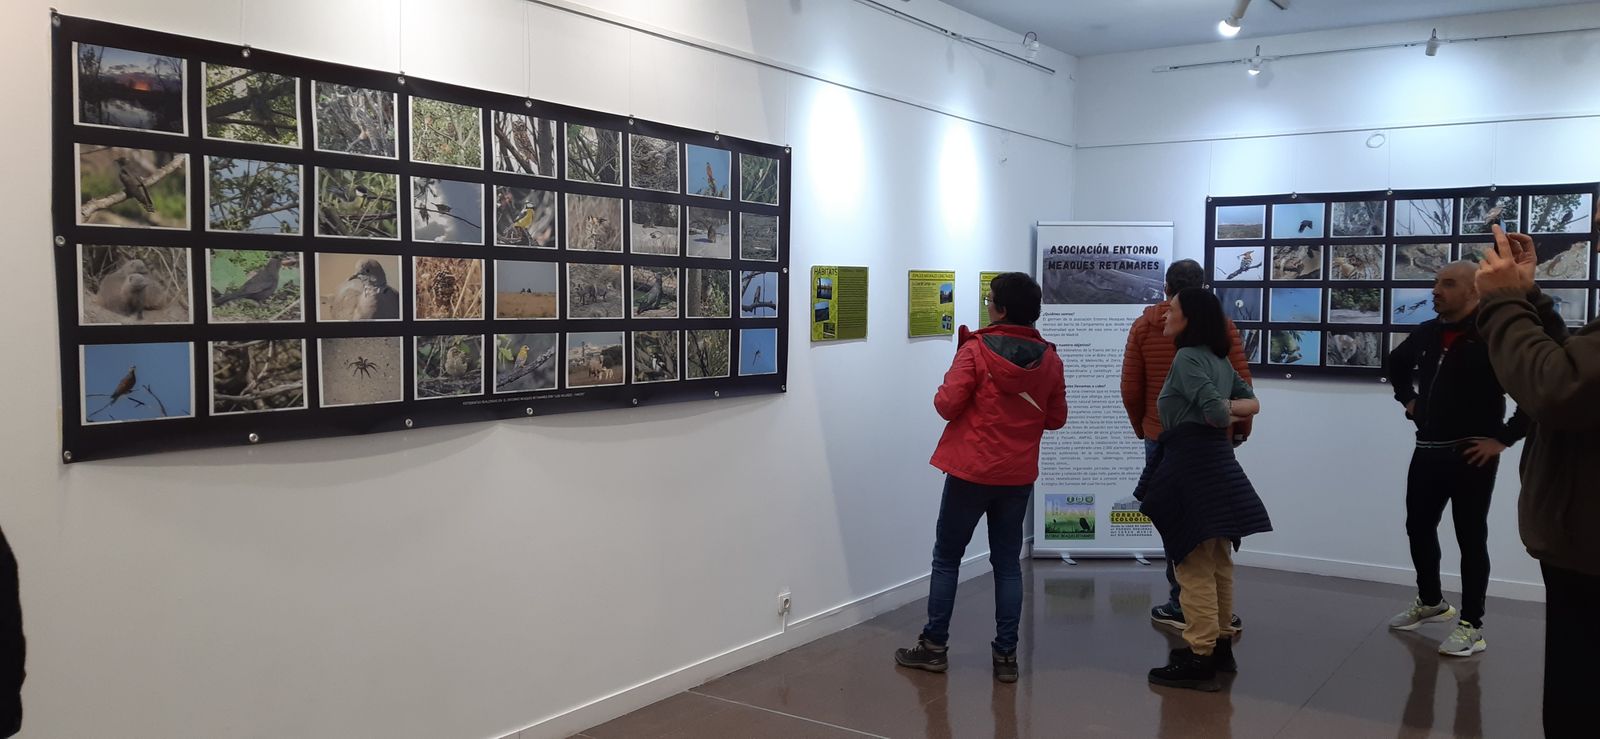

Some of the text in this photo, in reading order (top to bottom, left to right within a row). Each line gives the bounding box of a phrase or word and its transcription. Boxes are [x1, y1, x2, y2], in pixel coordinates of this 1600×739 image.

[1050, 243, 1158, 255] ASOCIACIÓN ENTORNO
[1048, 261, 1159, 270] MEAQUES RETAMARES
